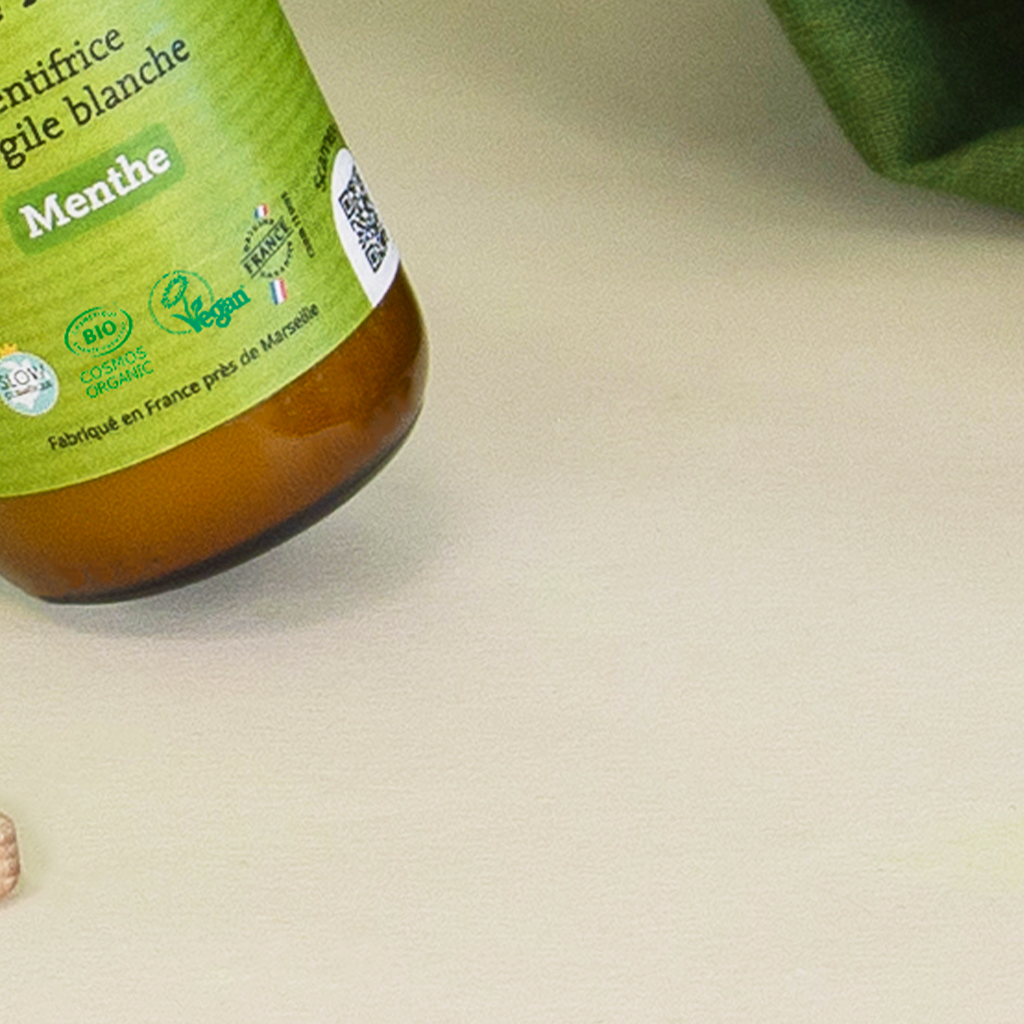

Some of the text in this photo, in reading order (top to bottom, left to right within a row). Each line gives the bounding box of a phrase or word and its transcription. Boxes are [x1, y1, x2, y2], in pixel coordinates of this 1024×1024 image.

[63, 39, 190, 129] blanche
[19, 147, 171, 238] Menthe
[243, 219, 289, 274] FRANCE
[82, 320, 117, 345] BIO
[172, 289, 251, 333] Vegan
[48, 303, 320, 451] Fabriqué en France près de Marseille
[80, 345, 147, 384] COSMOS
[86, 360, 154, 398] ORGANIC
